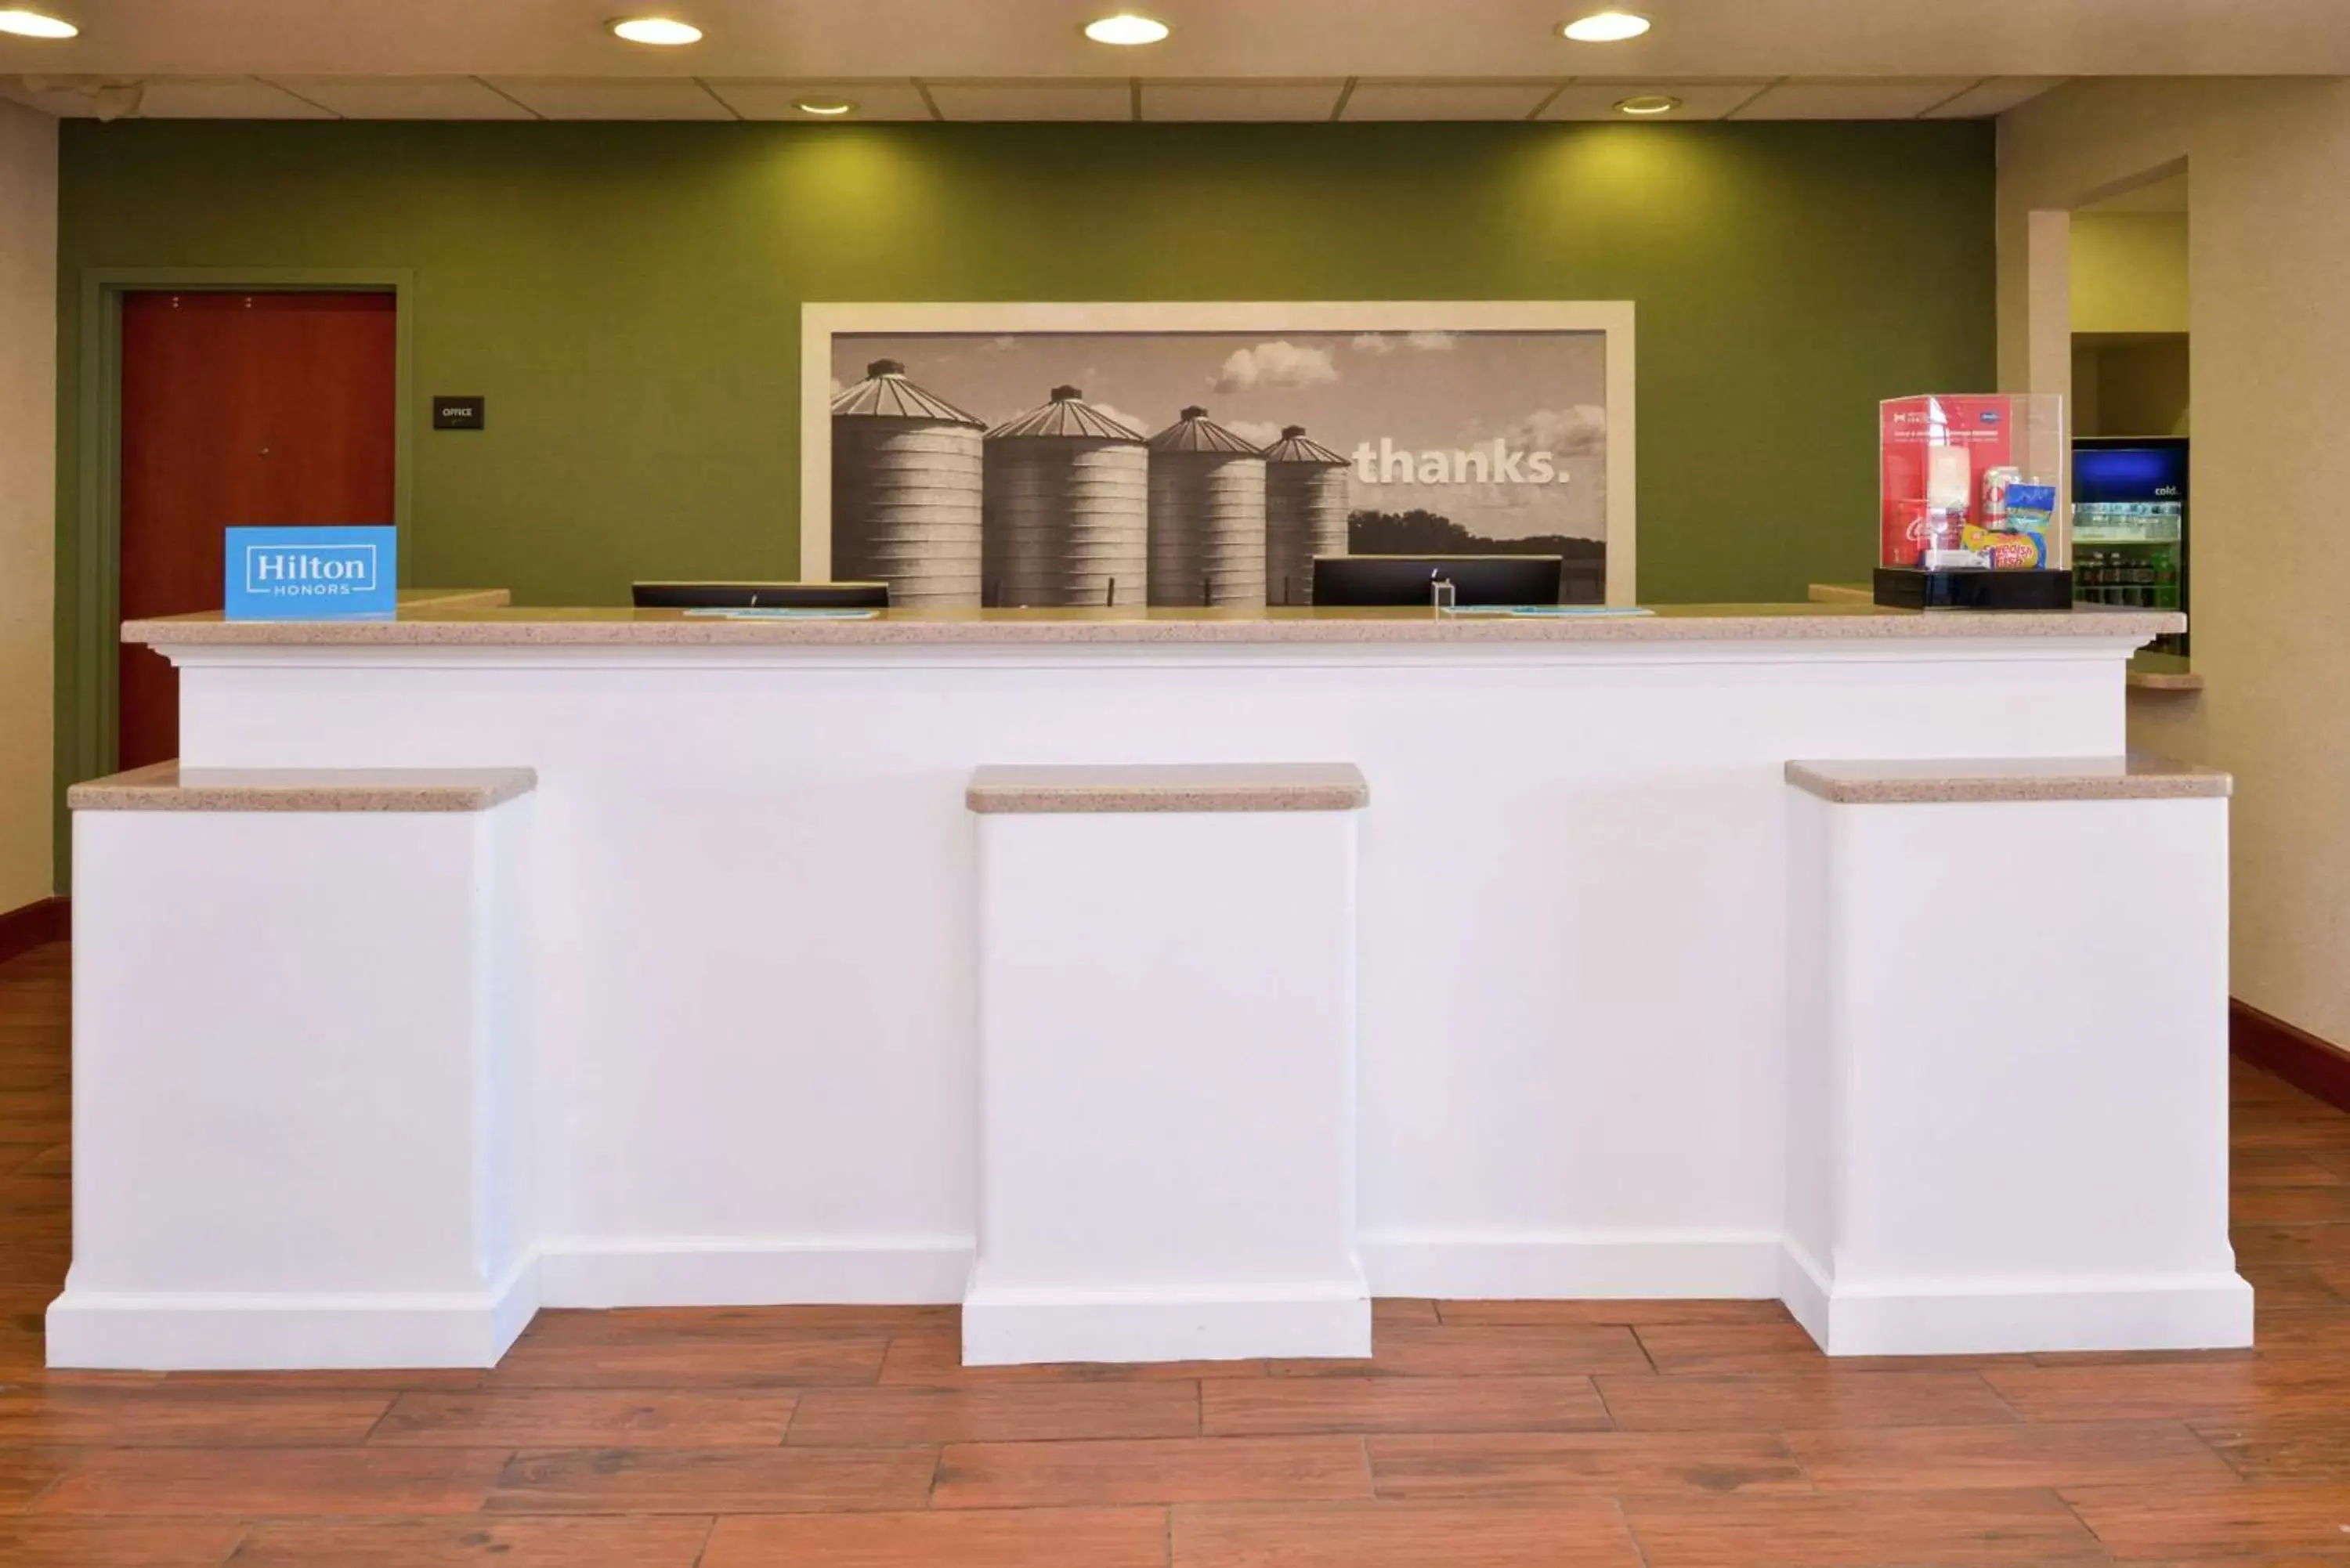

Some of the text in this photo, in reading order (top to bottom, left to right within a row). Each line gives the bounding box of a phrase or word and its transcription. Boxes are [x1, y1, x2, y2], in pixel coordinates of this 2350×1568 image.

[443, 408, 472, 417] OFFICE
[1352, 437, 1571, 484] thanks.
[258, 555, 365, 580] Hilton
[274, 584, 349, 596] HONORS
